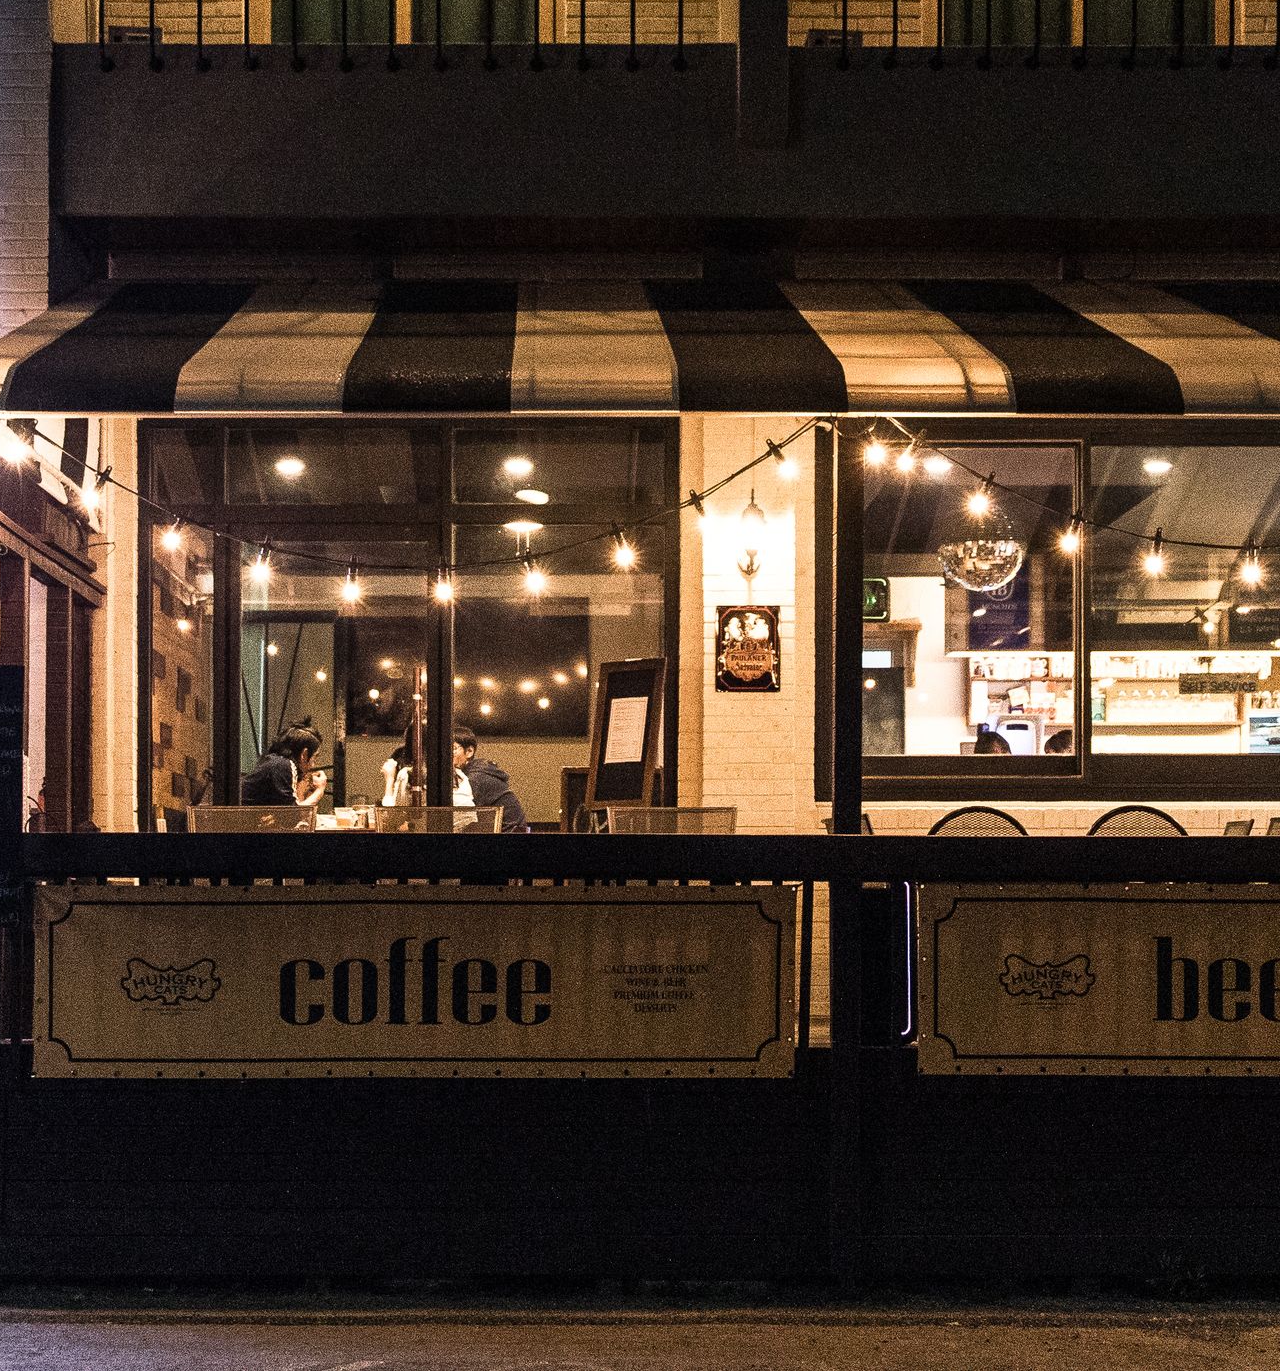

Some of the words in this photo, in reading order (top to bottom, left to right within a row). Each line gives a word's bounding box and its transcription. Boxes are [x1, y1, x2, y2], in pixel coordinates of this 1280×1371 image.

[132, 973, 208, 989] HUNGRY
[279, 936, 553, 1026] coffee
[1011, 968, 1082, 985] HUNGRY
[1031, 980, 1063, 990] CATS
